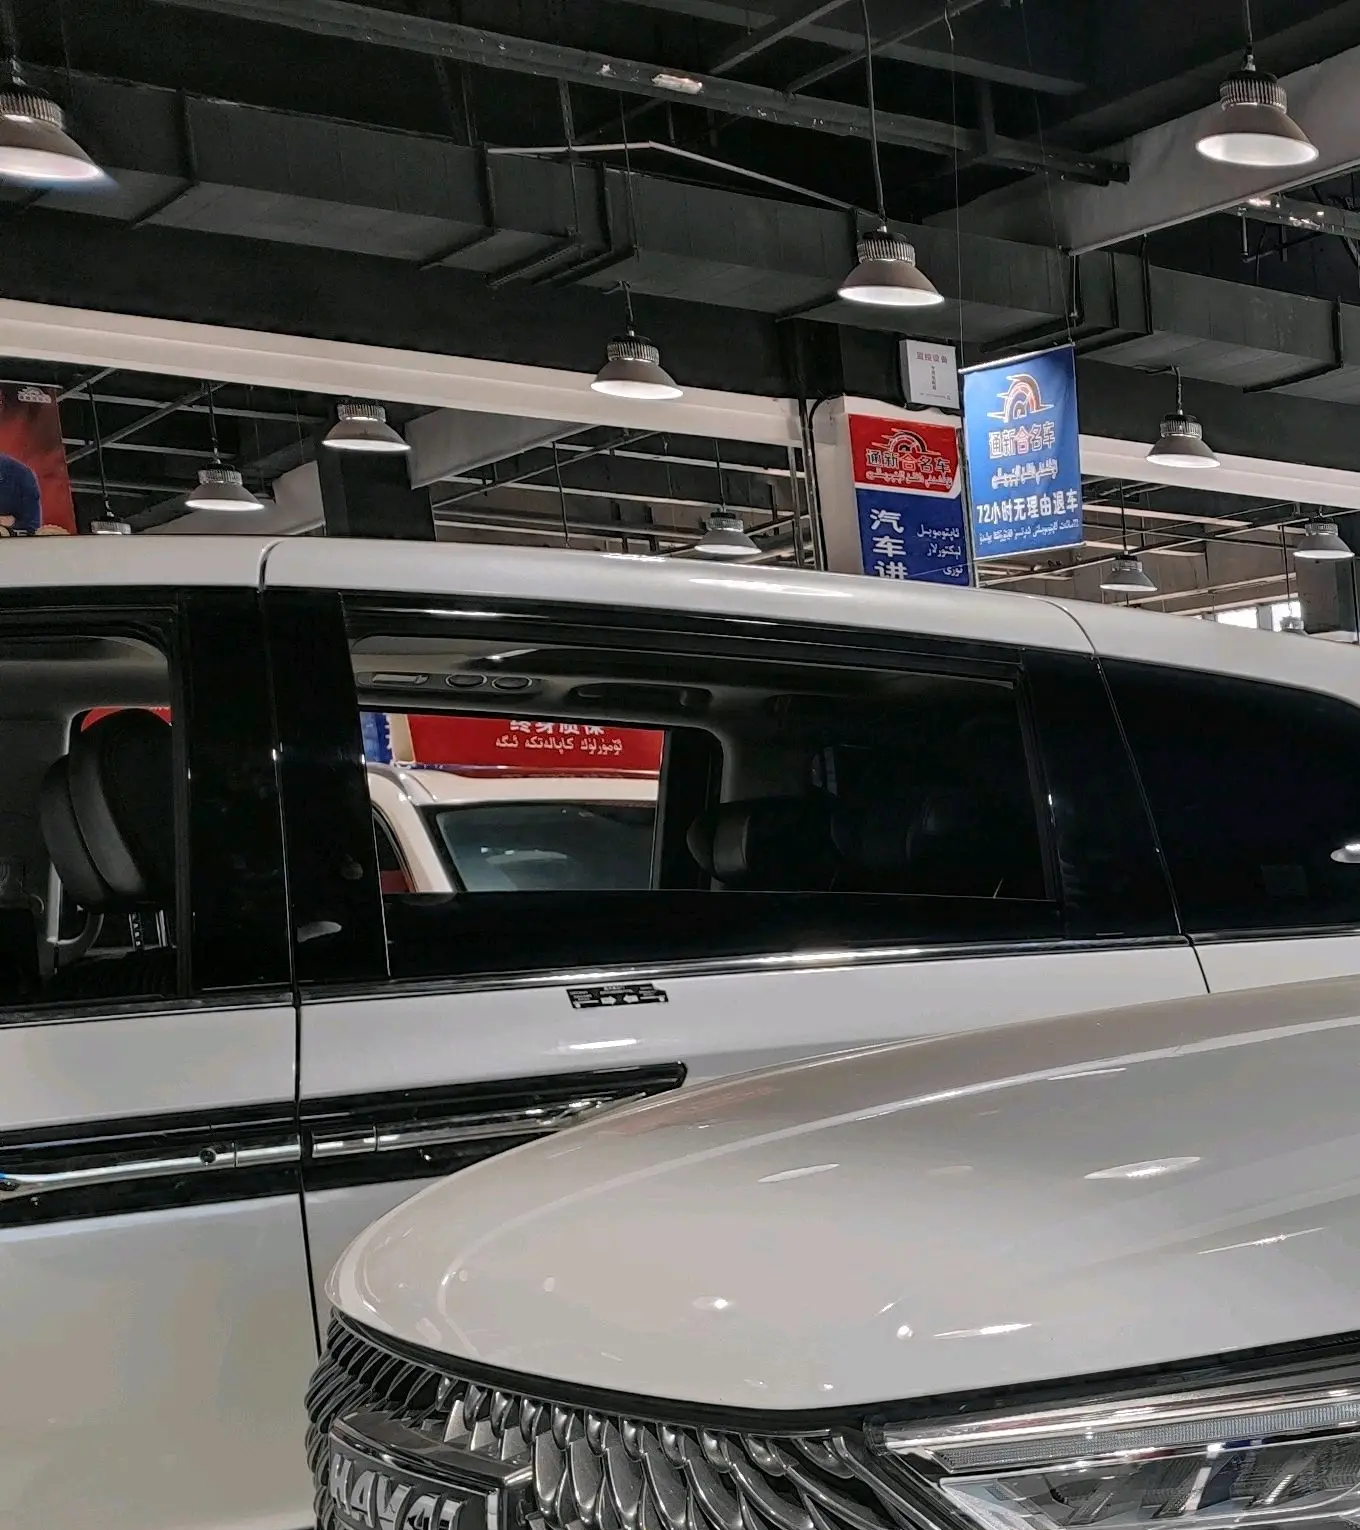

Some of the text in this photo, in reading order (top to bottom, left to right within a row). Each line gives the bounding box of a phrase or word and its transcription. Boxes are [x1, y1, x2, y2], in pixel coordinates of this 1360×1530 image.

[988, 421, 1055, 459] 通新合名车
[866, 449, 951, 474] 通新合名车
[977, 488, 1078, 525] 72小时无理由退车
